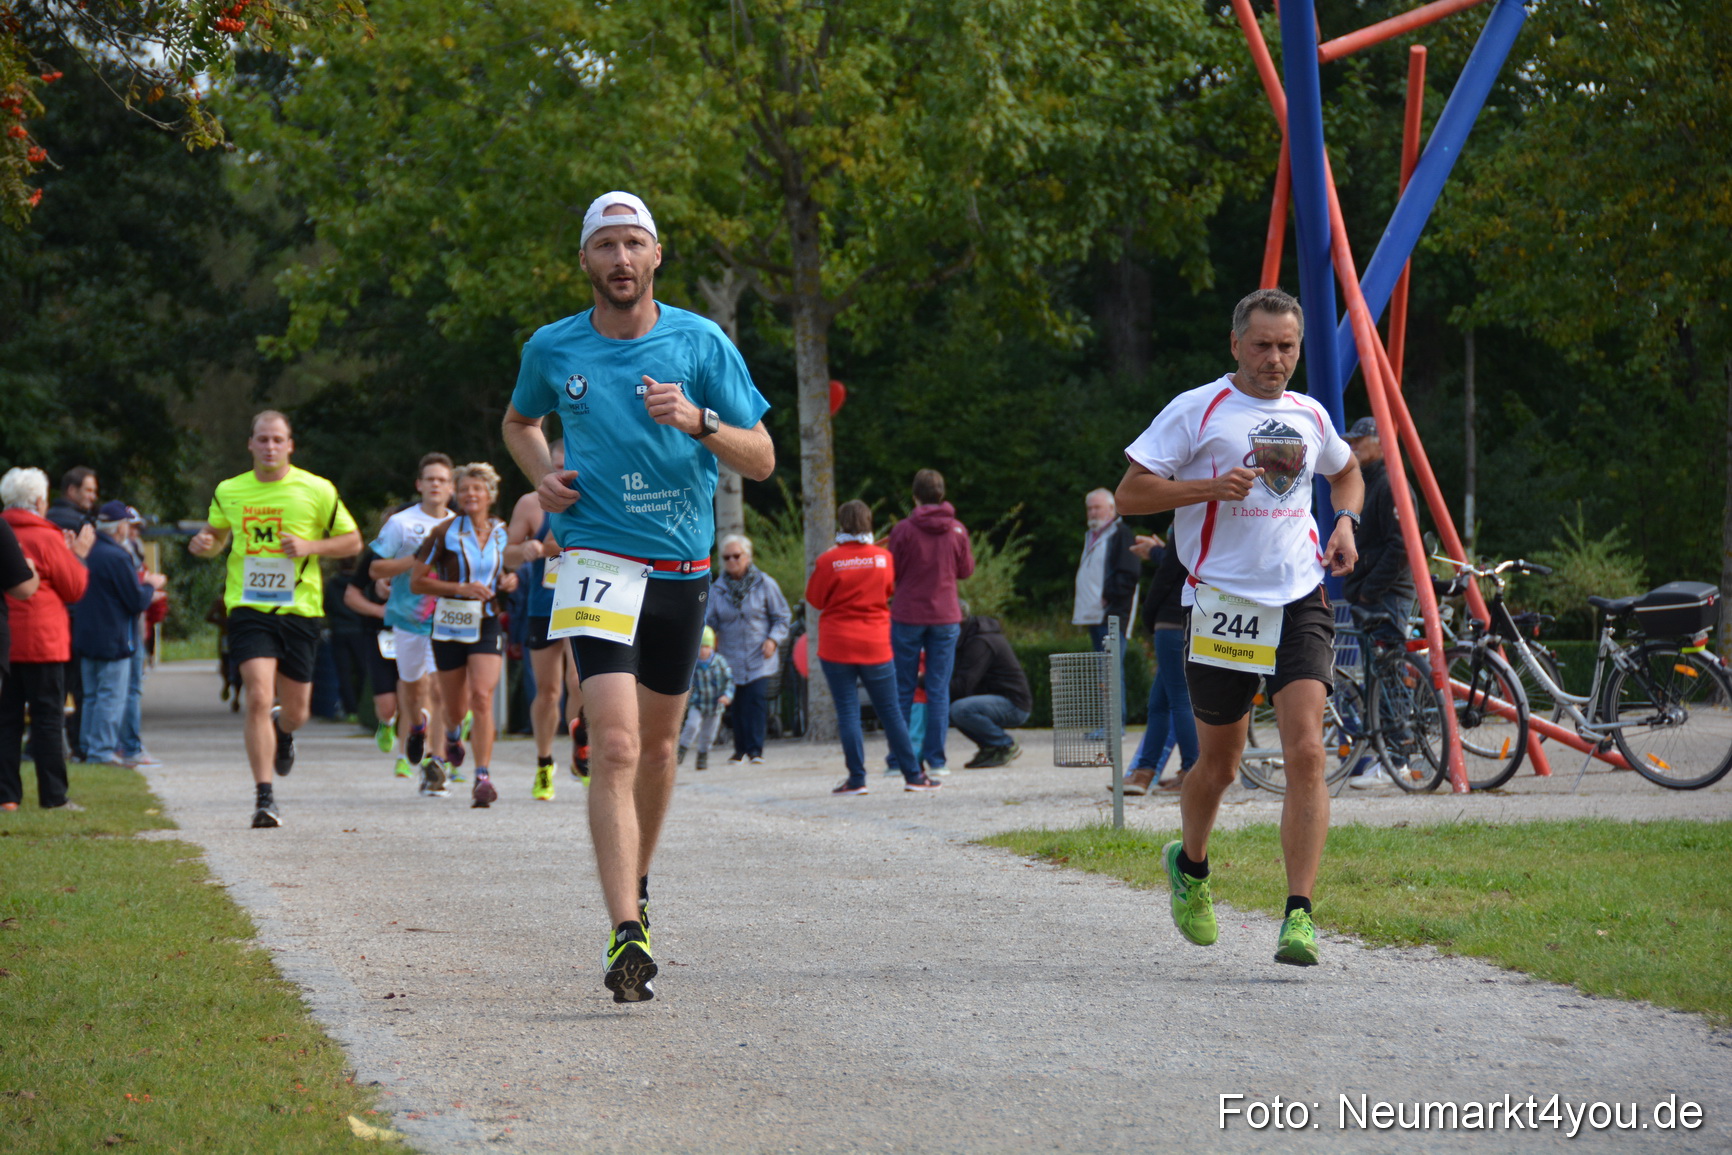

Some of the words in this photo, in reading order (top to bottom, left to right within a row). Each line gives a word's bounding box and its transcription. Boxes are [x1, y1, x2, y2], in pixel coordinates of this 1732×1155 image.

[621, 472, 649, 490] 18.
[623, 489, 681, 501] Neumarkter
[243, 506, 284, 515] Müller
[625, 500, 671, 513] Stadtlauf
[1232, 507, 1237, 516] I
[1241, 507, 1268, 517] hobs
[254, 527, 273, 543] M
[249, 572, 286, 588] 2372
[578, 576, 612, 603] 17
[440, 610, 473, 625] 2698
[575, 611, 600, 622] Claus
[1212, 612, 1259, 639] 244
[1213, 643, 1254, 659] Wolfgang
